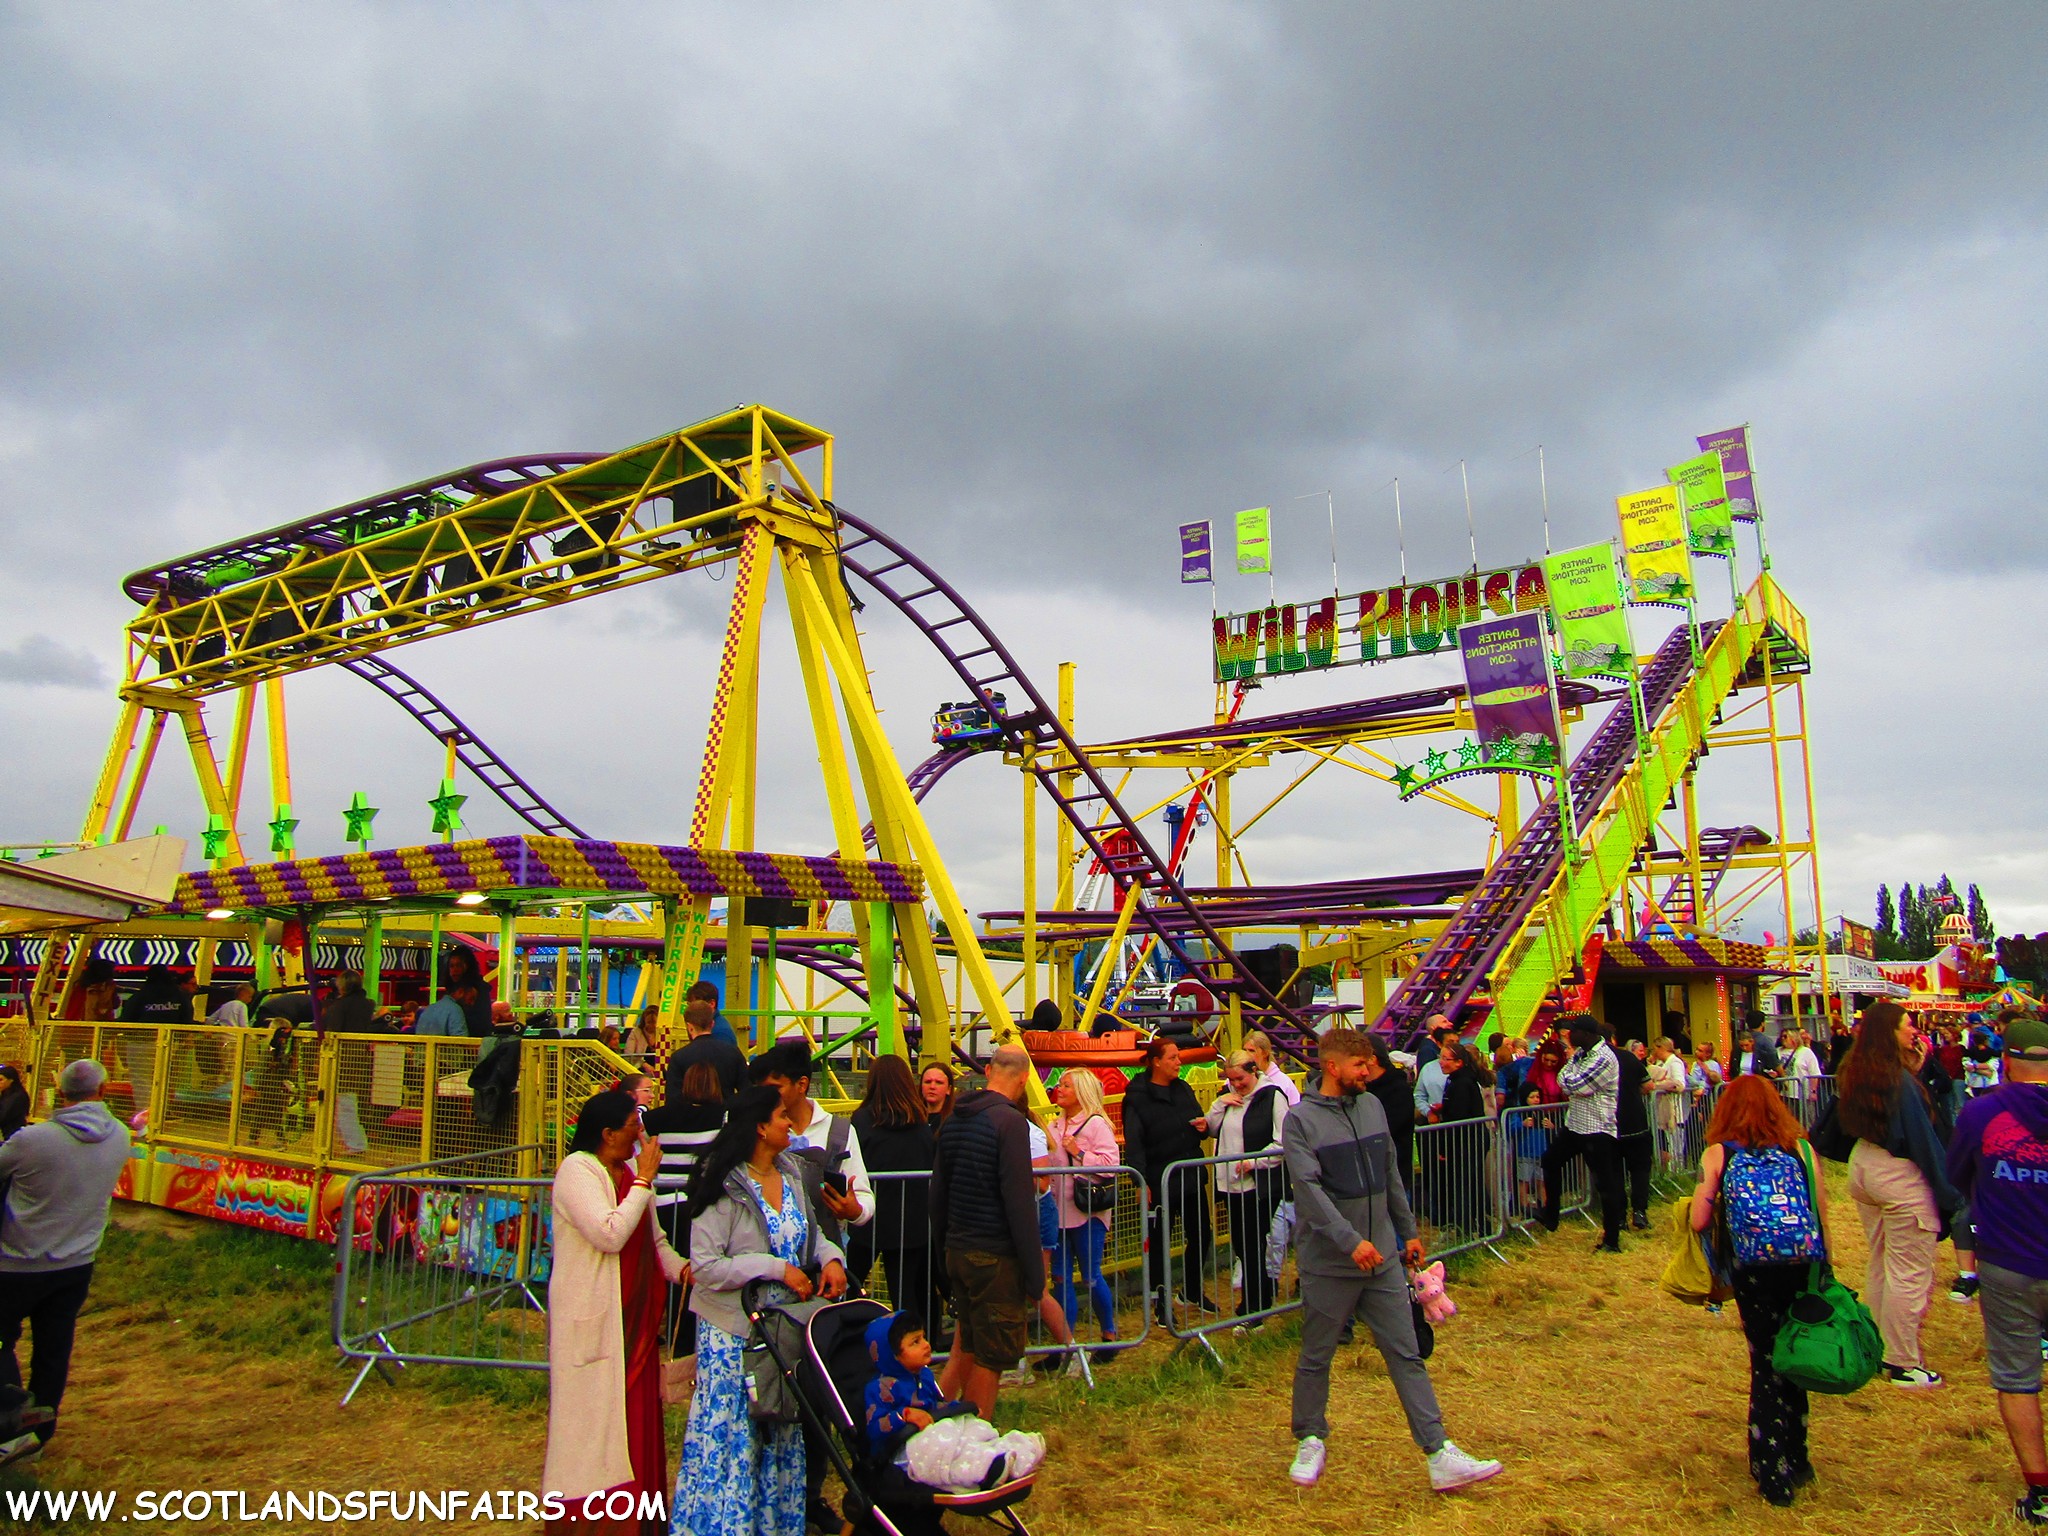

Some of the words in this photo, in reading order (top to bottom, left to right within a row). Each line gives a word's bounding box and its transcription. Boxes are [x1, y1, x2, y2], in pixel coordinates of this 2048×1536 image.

[660, 910, 693, 1013] ENTRANCE
[689, 911, 706, 958] WAIT
[39, 942, 64, 1008] EXIT
